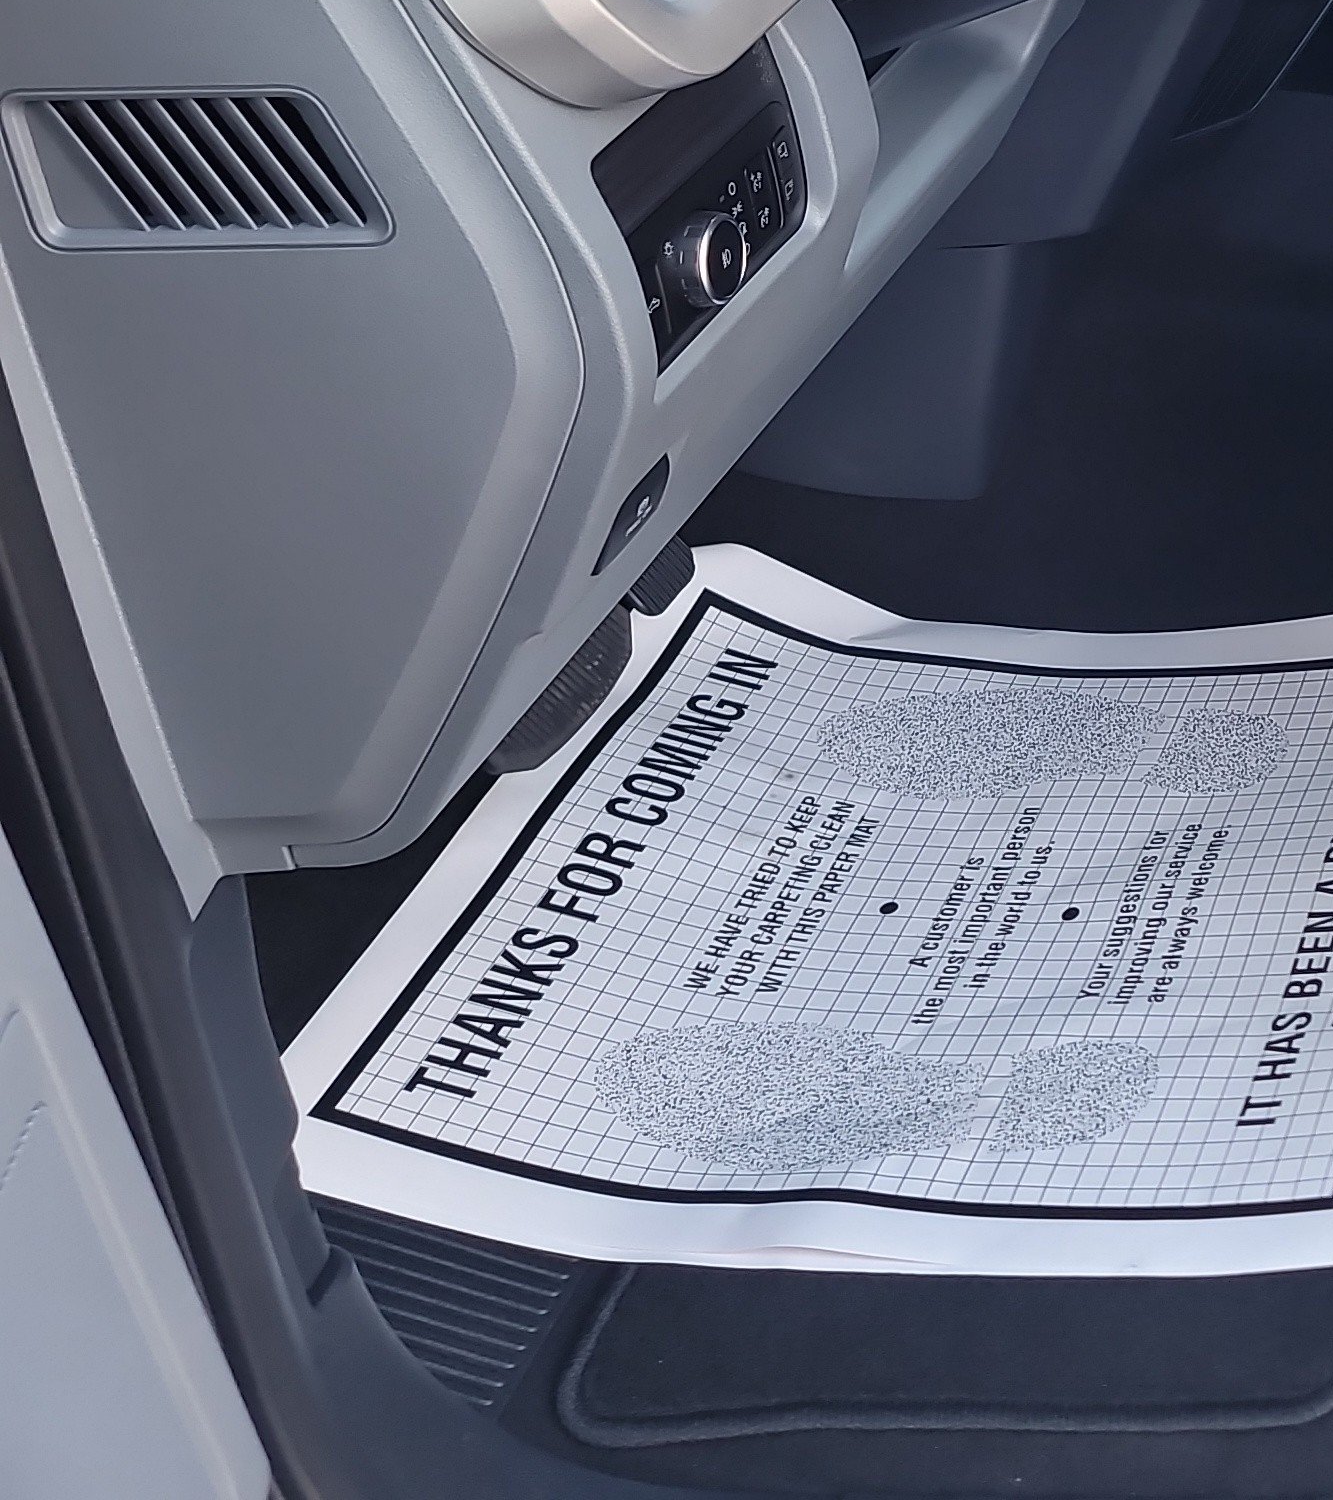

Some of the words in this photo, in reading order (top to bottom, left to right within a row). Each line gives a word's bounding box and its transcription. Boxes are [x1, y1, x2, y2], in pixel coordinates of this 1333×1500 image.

[404, 928, 579, 1099] THANKS
[537, 832, 646, 922] FOR
[604, 694, 749, 827] COMING
[709, 648, 778, 691] IN
[684, 961, 720, 989] WE
[704, 914, 749, 959] HAVE
[734, 862, 781, 908] TRIED
[768, 836, 797, 857] TO
[784, 796, 821, 834] KEEP
[715, 950, 764, 996] YOUR
[750, 855, 824, 945] CARPETING
[809, 800, 855, 850] CLEAN
[755, 949, 800, 993] WITH
[786, 907, 825, 943] THIS
[812, 851, 860, 903] PAPER
[845, 816, 880, 848] MAT
[909, 956, 933, 968] A
[921, 872, 975, 951] customer
[960, 856, 985, 871] is
[911, 997, 944, 1026] the
[933, 949, 969, 992] most
[953, 865, 1011, 944] important
[1001, 807, 1040, 861] person
[995, 891, 1032, 937] world
[1017, 870, 1041, 887] to
[1031, 840, 1056, 866] us.
[1076, 963, 1114, 999] Your
[1103, 854, 1158, 958] suggestions
[1143, 830, 1170, 850] for
[1107, 917, 1167, 1005] improving
[1152, 882, 1176, 911] our
[1165, 823, 1202, 878] service
[1148, 976, 1173, 1003] are
[1161, 905, 1198, 970] always
[1186, 824, 1232, 901] welcome.
[963, 972, 991, 988] in
[975, 941, 1006, 968] the
[1236, 1095, 1282, 1127] IT
[1251, 1011, 1312, 1082] HAS
